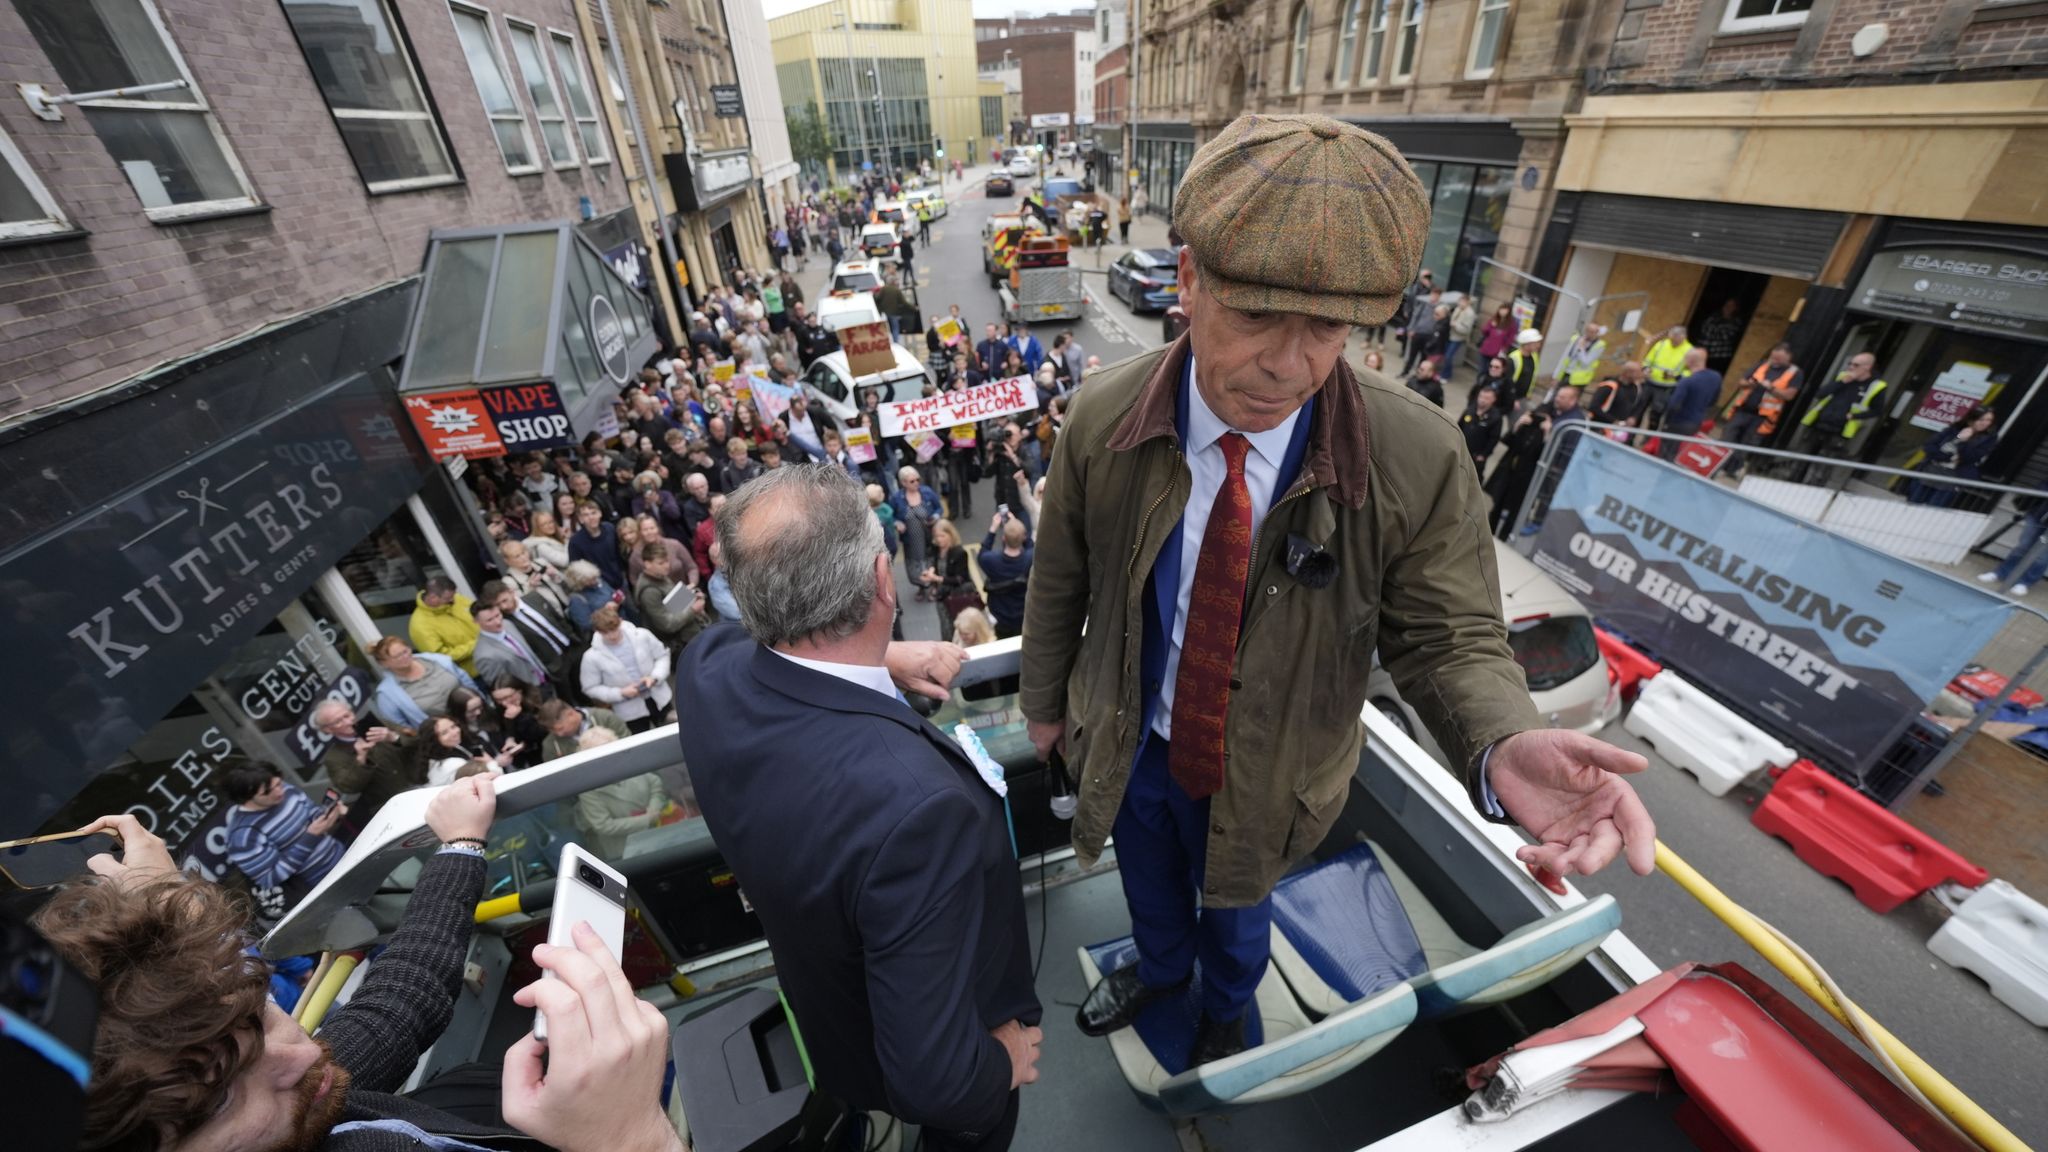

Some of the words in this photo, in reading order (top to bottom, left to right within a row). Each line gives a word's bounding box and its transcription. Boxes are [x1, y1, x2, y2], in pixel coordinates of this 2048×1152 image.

[1912, 255, 1992, 276] BARBER
[484, 384, 557, 414] VAPE
[893, 379, 1020, 417] IMMIGRANTS
[903, 413, 940, 432] ARE
[952, 390, 1026, 420] WELCOME
[1933, 391, 1974, 409] OPEN
[497, 414, 569, 444] SHOP
[67, 461, 342, 679] KUTTERS
[1569, 531, 1638, 584] OUR
[1595, 493, 1886, 648] REVITALISING
[197, 592, 259, 646] LADIES
[260, 582, 273, 596] &
[273, 544, 318, 584] GENTS
[241, 618, 338, 720] GENTS
[286, 663, 332, 714] CUTS
[166, 788, 218, 850] IMS
